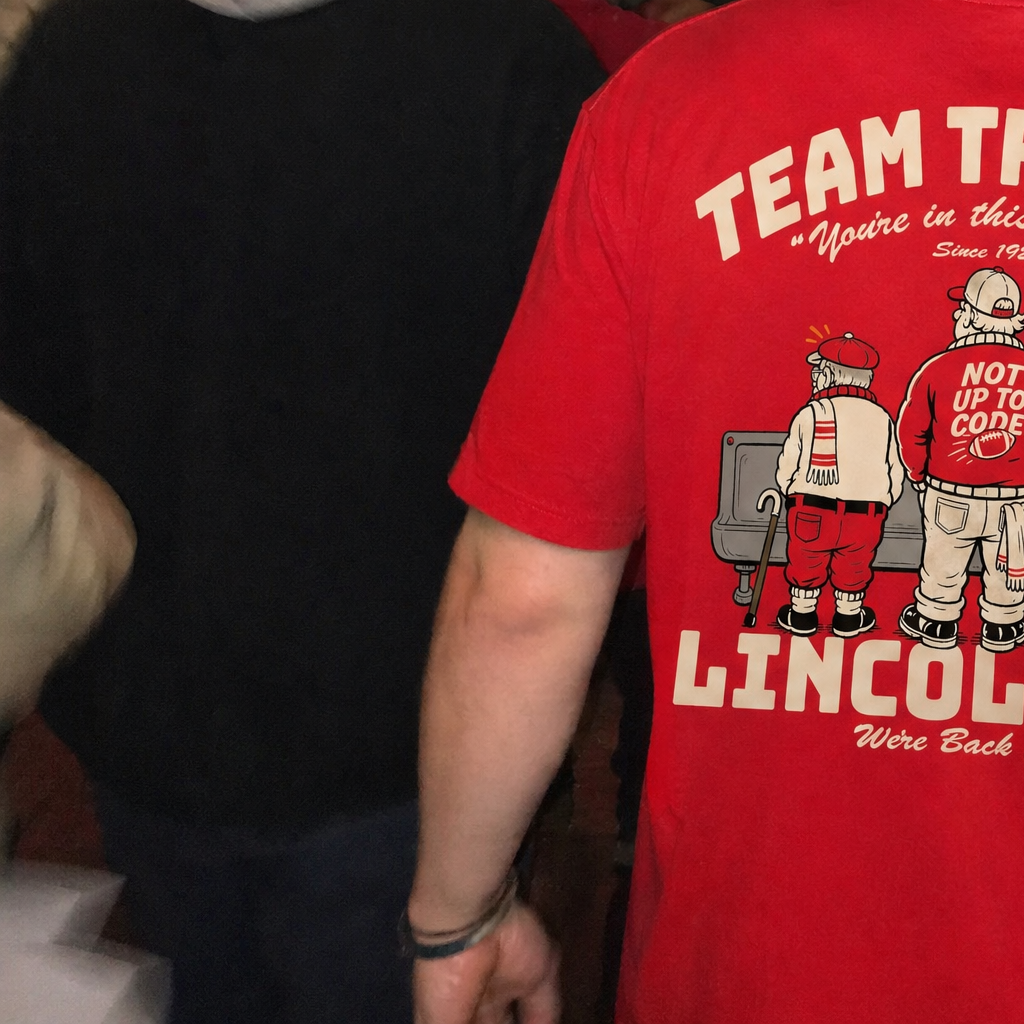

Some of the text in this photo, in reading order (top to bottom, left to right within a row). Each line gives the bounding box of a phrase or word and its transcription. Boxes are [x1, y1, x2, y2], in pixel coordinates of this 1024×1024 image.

[695, 108, 923, 262] TEAM
[923, 203, 957, 228] in
[931, 241, 988, 259] Since
[953, 387, 990, 413] UP
[853, 723, 928, 751] We're
[940, 727, 1014, 757] Back
